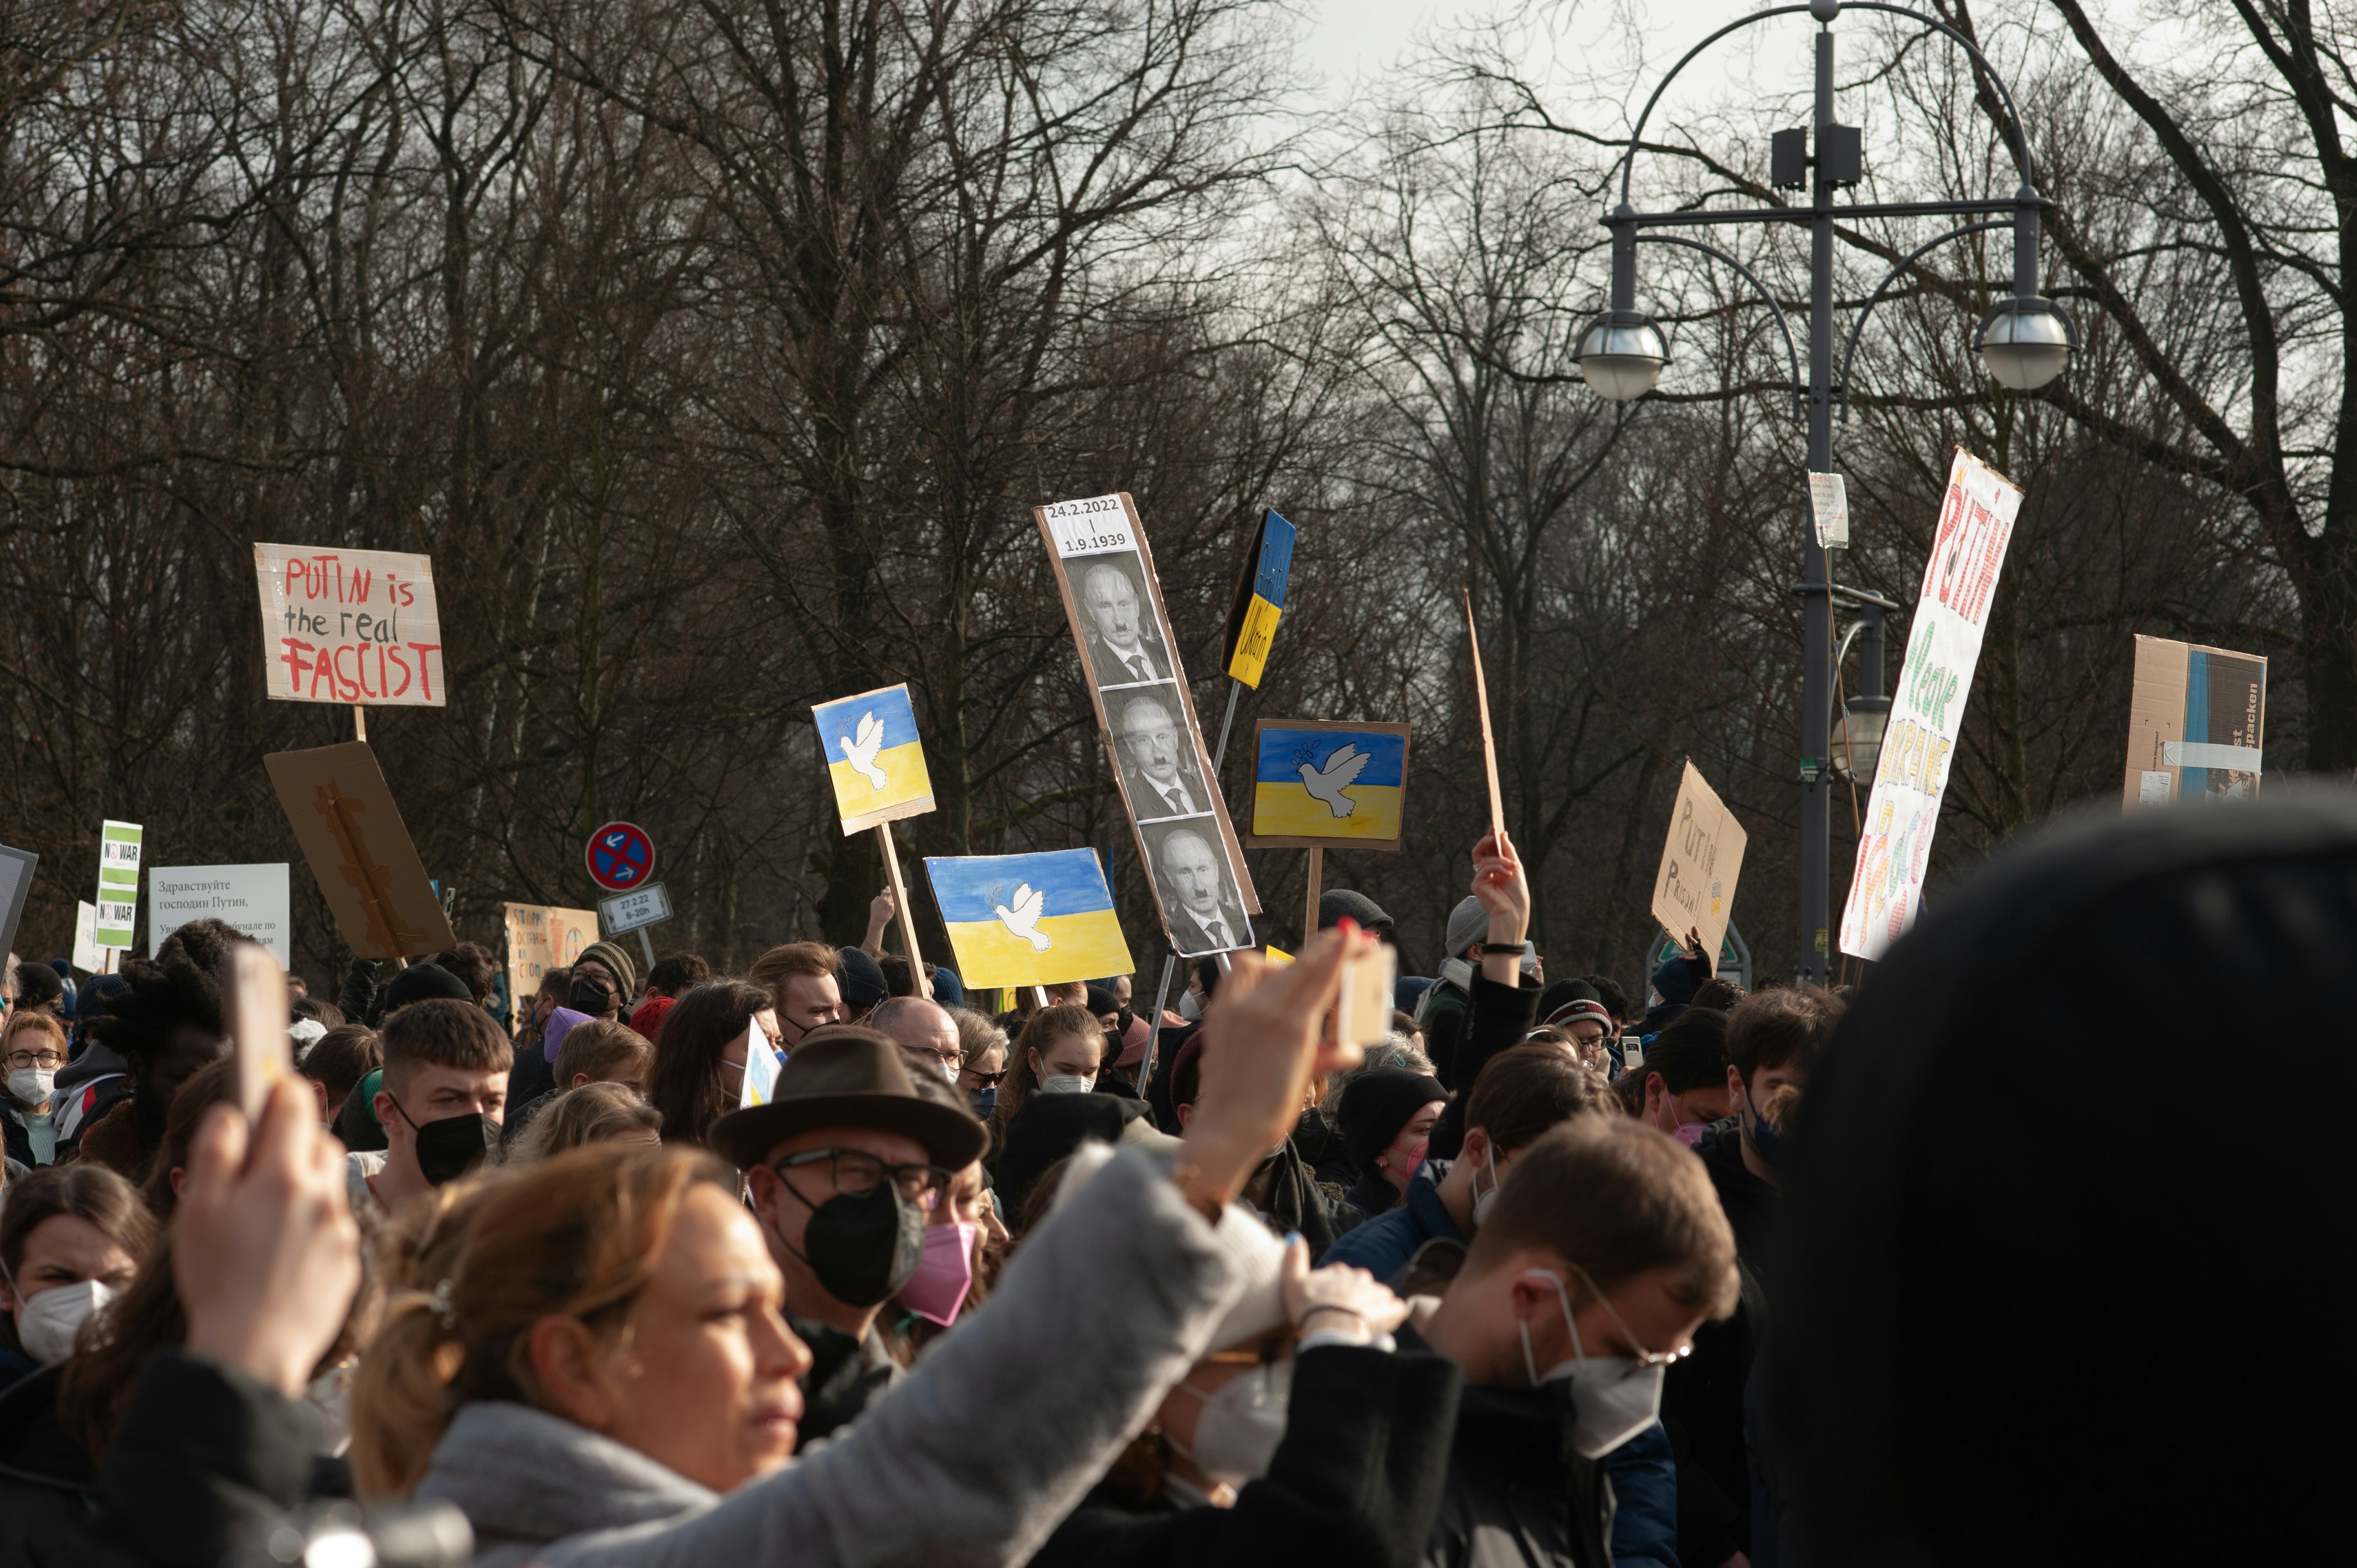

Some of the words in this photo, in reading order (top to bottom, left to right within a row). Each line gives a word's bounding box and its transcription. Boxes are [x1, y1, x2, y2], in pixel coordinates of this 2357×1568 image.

[1048, 499, 1119, 518] 24.2.2022
[1065, 533, 1125, 551] 1.9.1939
[1924, 482, 2010, 626] PUTIN
[286, 555, 371, 606] PUTIN
[387, 574, 414, 607] is
[284, 604, 330, 636] the
[341, 607, 399, 643] real
[281, 637, 442, 702] FASCIST
[1879, 718, 1951, 798] UKRAINE
[1676, 796, 1717, 879] PUTIN
[120, 844, 137, 862] WAR
[158, 880, 230, 895] Здравствуйте
[159, 899, 209, 910] господин
[212, 896, 248, 911] Путин,
[620, 895, 649, 910] 27.2.22
[114, 905, 132, 922] WAR
[513, 909, 541, 926] STOPP
[626, 907, 650, 920] 8-20h
[232, 921, 263, 931] бунале
[265, 922, 276, 930] по
